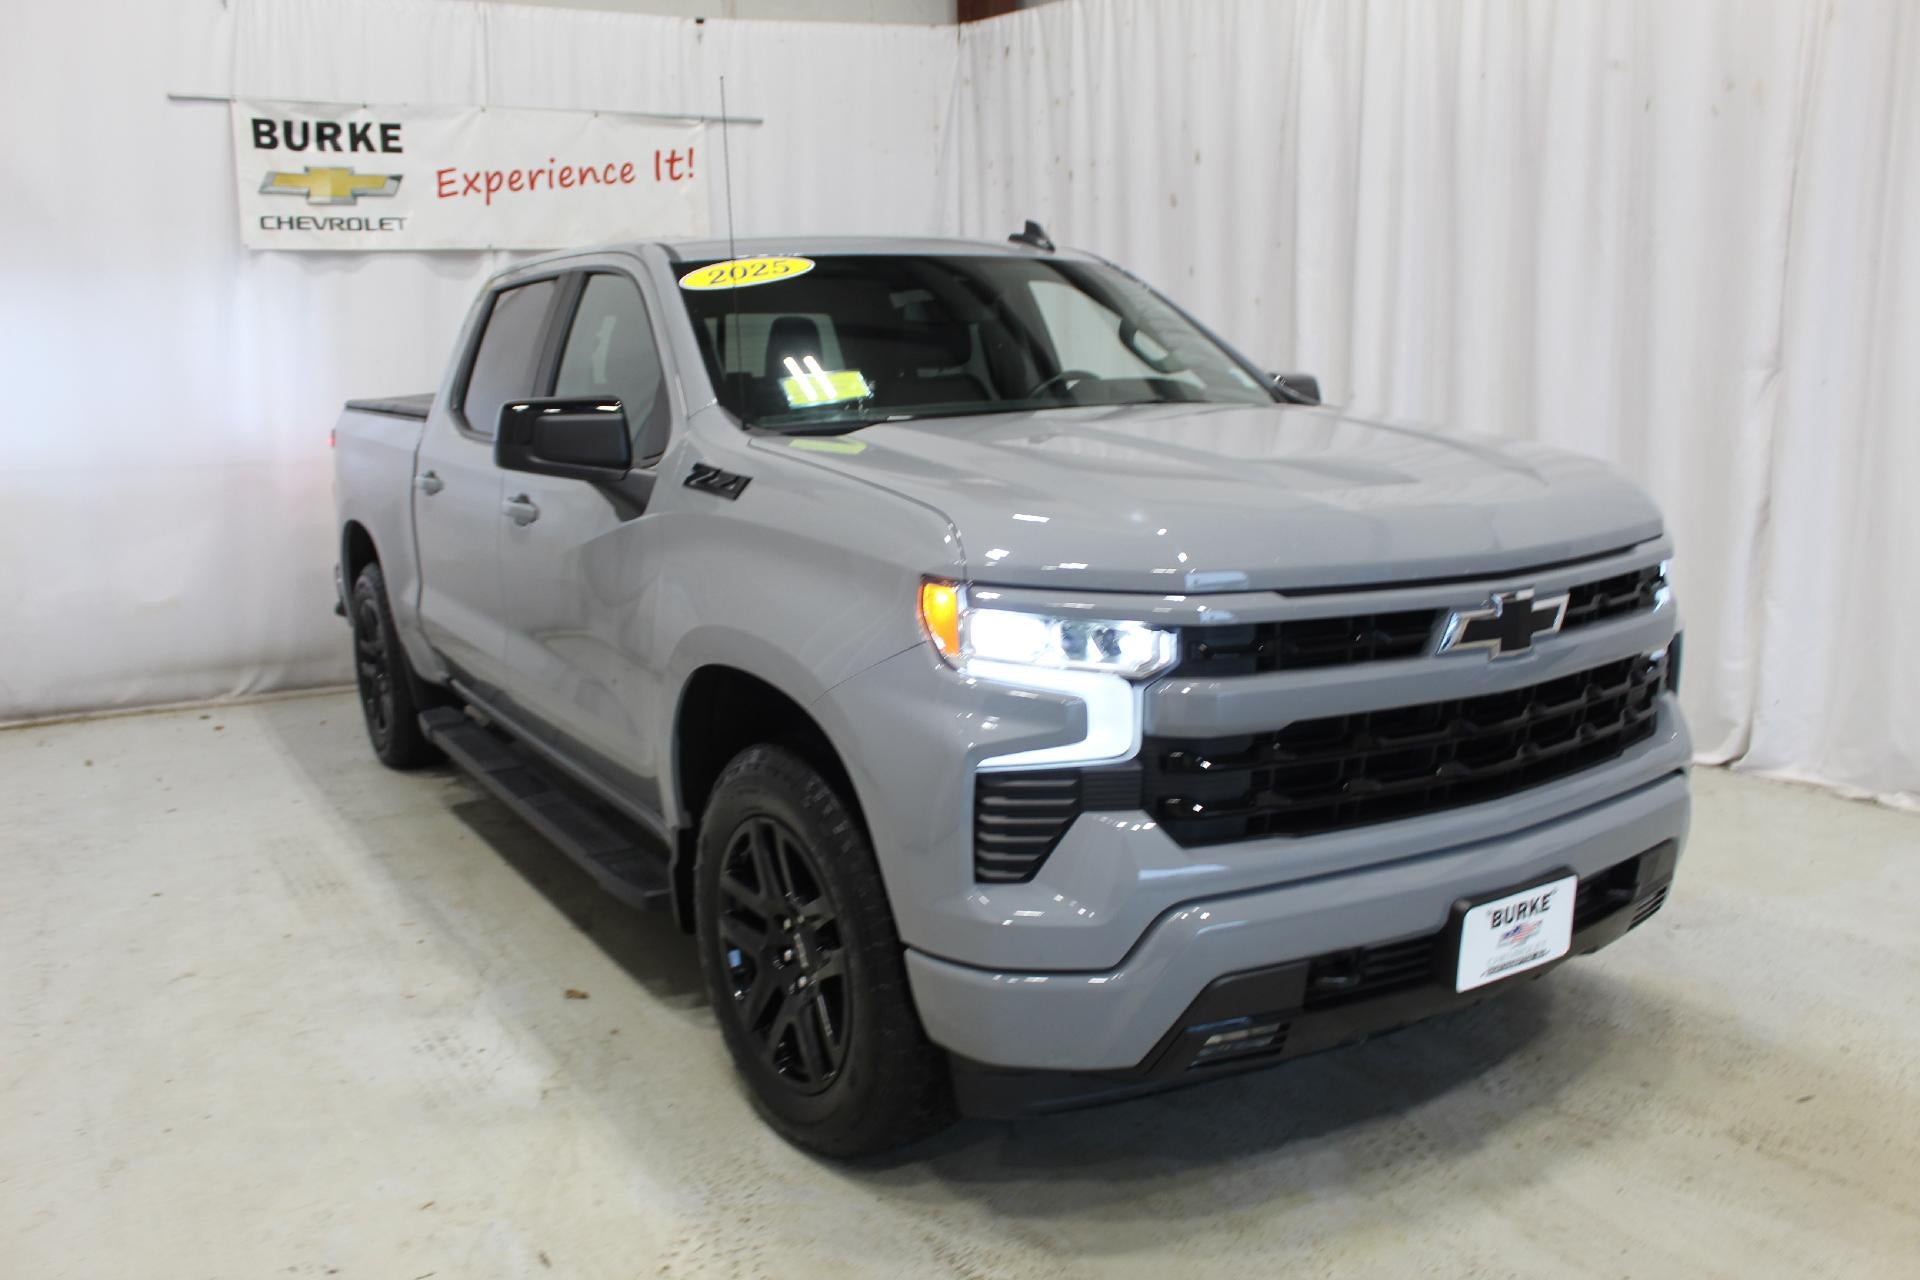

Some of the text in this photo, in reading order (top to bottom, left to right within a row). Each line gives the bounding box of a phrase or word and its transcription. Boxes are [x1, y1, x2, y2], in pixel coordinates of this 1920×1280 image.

[252, 118, 403, 153] BURKE
[436, 147, 694, 206] Experience It!
[260, 215, 407, 231] CHEVROLET
[708, 260, 790, 285] 2025
[1491, 893, 1552, 929] BURKE
